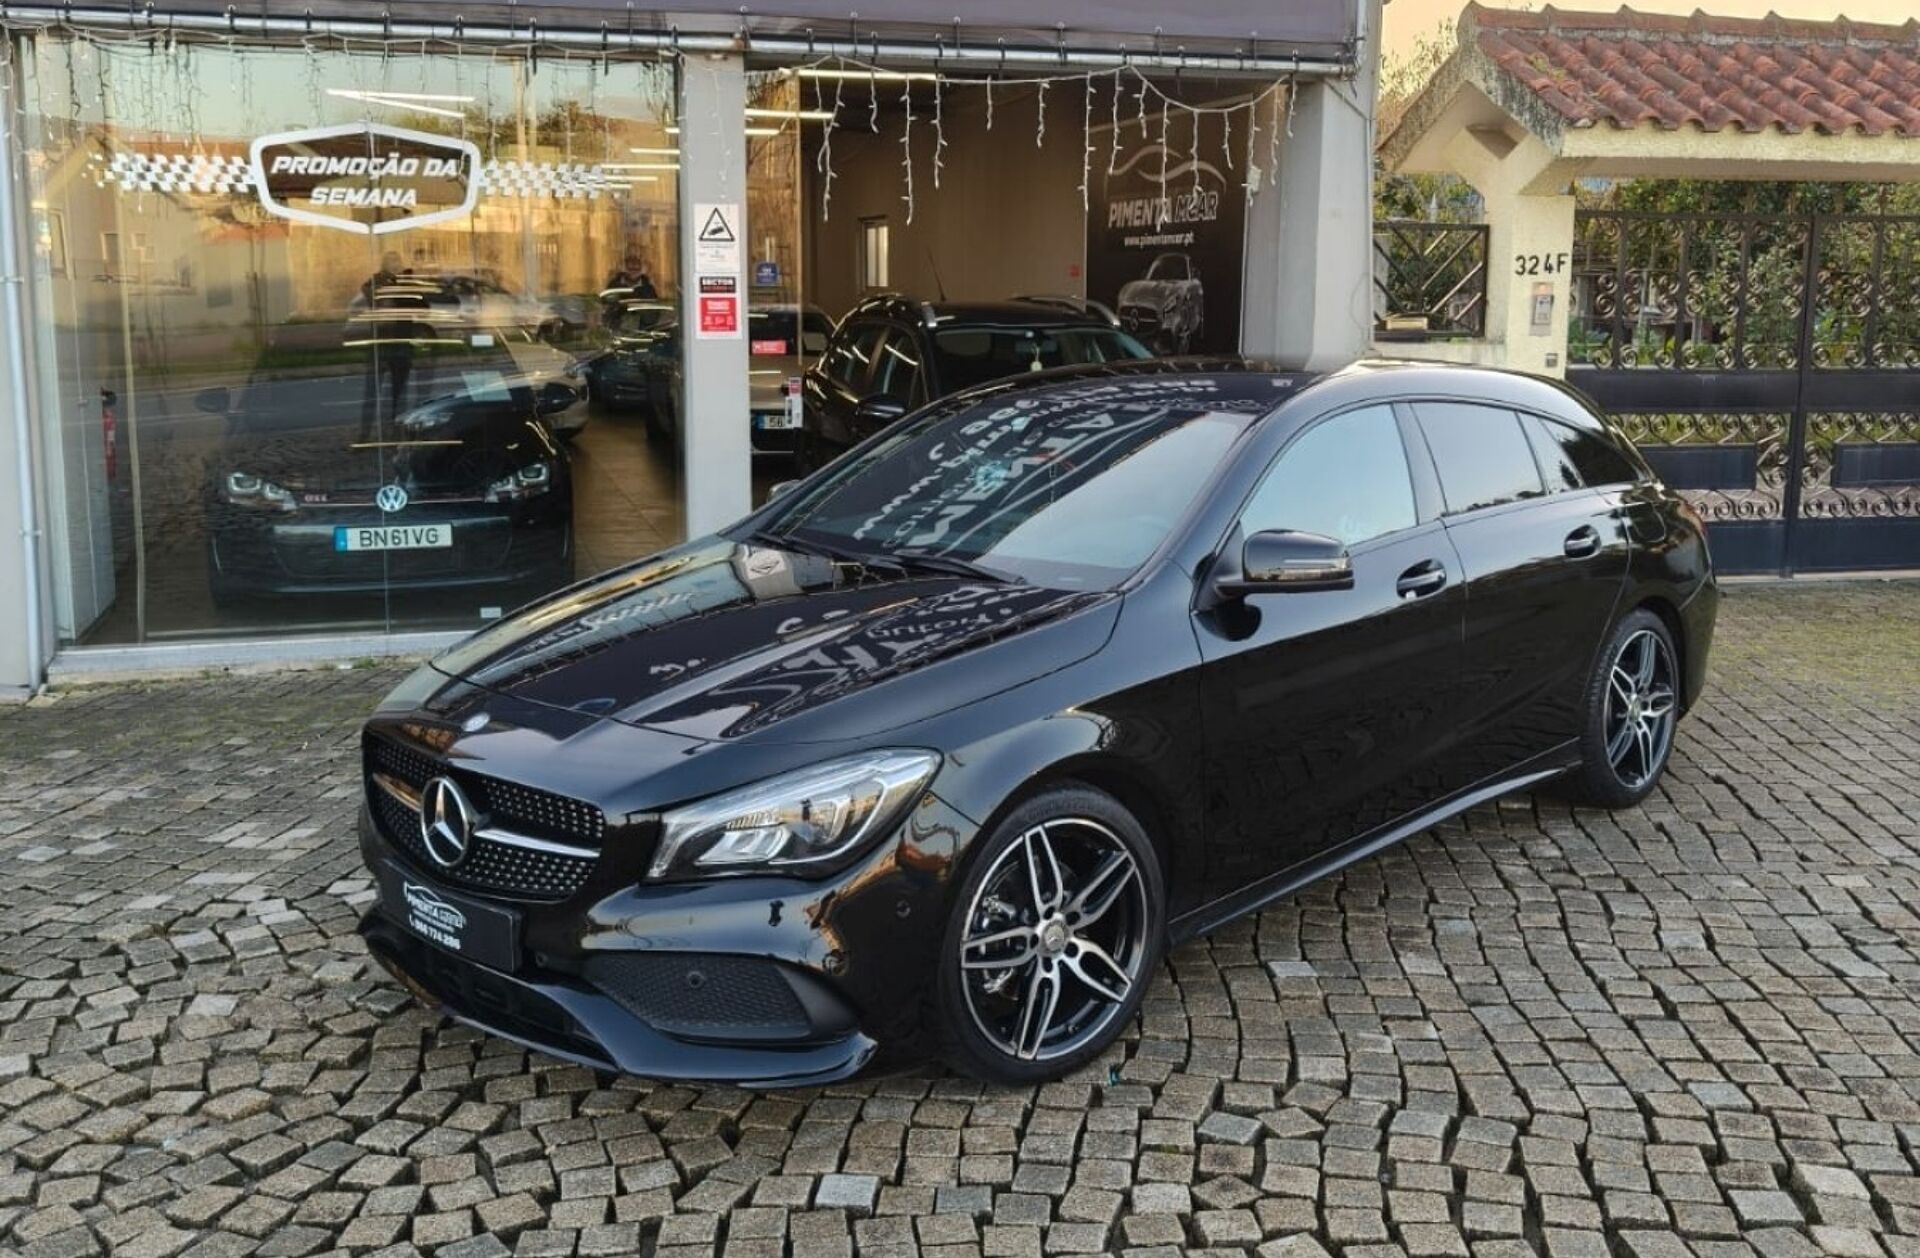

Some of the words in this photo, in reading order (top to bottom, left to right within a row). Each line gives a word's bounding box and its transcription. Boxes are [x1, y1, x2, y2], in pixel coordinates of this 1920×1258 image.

[270, 152, 419, 179] PROMOÇÃO
[422, 157, 458, 177] DA
[309, 186, 417, 207] SEMANA
[1108, 197, 1173, 228] PIMENTA
[1514, 252, 1569, 276] 324F
[359, 528, 440, 548] BN61VG
